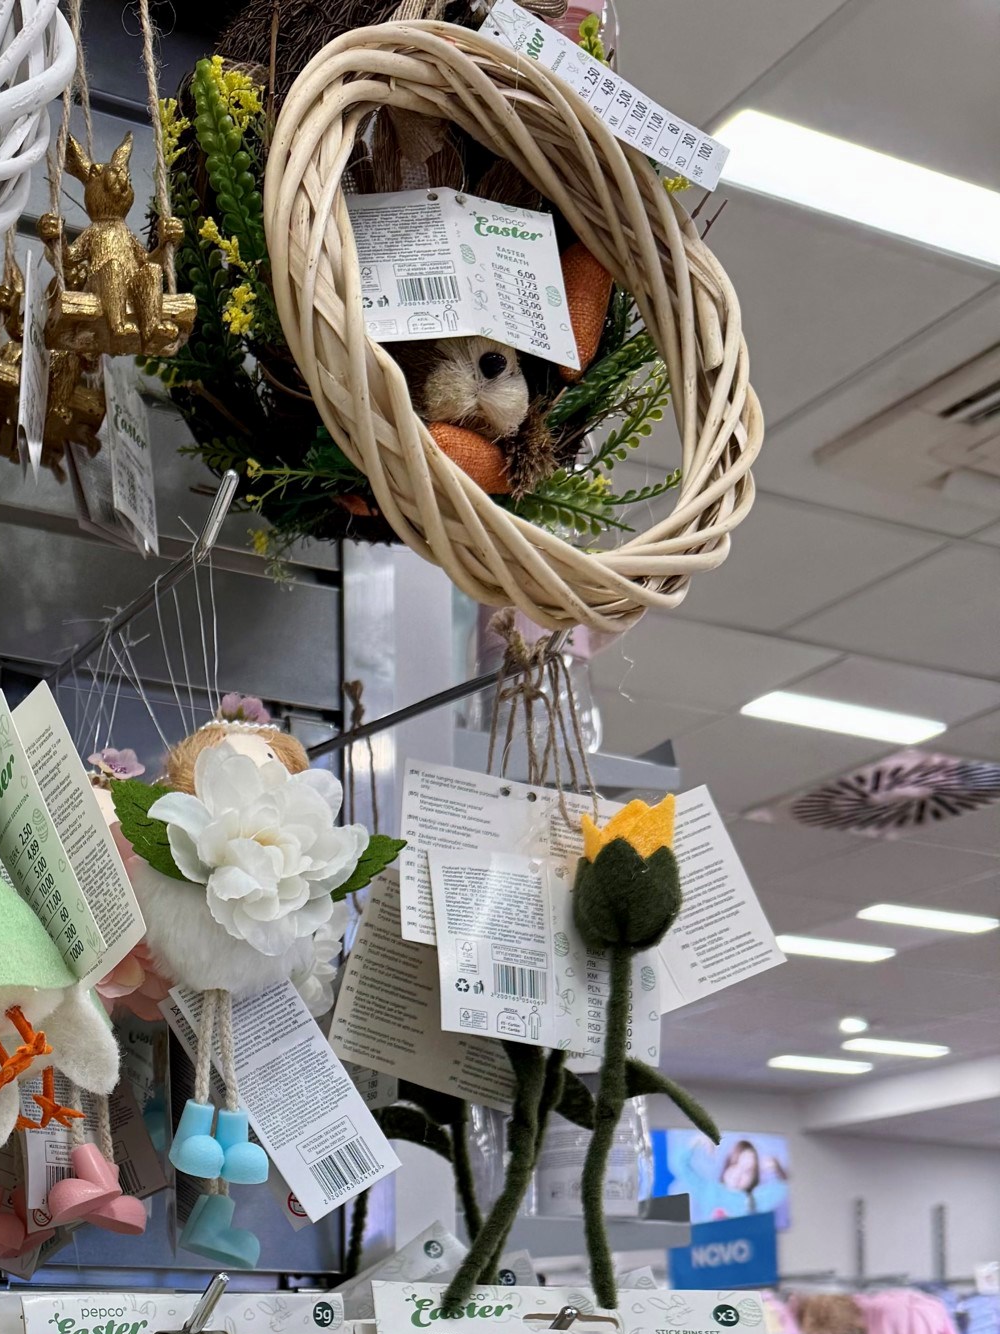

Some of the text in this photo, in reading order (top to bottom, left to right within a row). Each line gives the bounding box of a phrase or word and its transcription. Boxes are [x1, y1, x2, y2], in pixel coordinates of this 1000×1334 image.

[584, 67, 600, 85] 2,50
[616, 89, 632, 108] 5,00
[631, 101, 648, 122] 10,00
[647, 112, 664, 132] 11,00
[469, 211, 543, 241] Easter
[496, 252, 529, 267] WREATH
[497, 246, 525, 258] EASTER
[517, 270, 536, 280] 6,00
[515, 278, 538, 291] 11,73
[521, 308, 543, 321] 30,00
[530, 338, 550, 350] 2500
[18, 823, 33, 847] 2,50
[33, 856, 47, 879] 5,00
[39, 873, 54, 900] 10,00
[46, 890, 62, 915] 11,00
[69, 940, 84, 962] 1000
[692, 1238, 750, 1268] NOVO
[81, 1307, 124, 1319] pepco
[315, 1307, 332, 1323] 5g
[717, 1310, 736, 1321] x3
